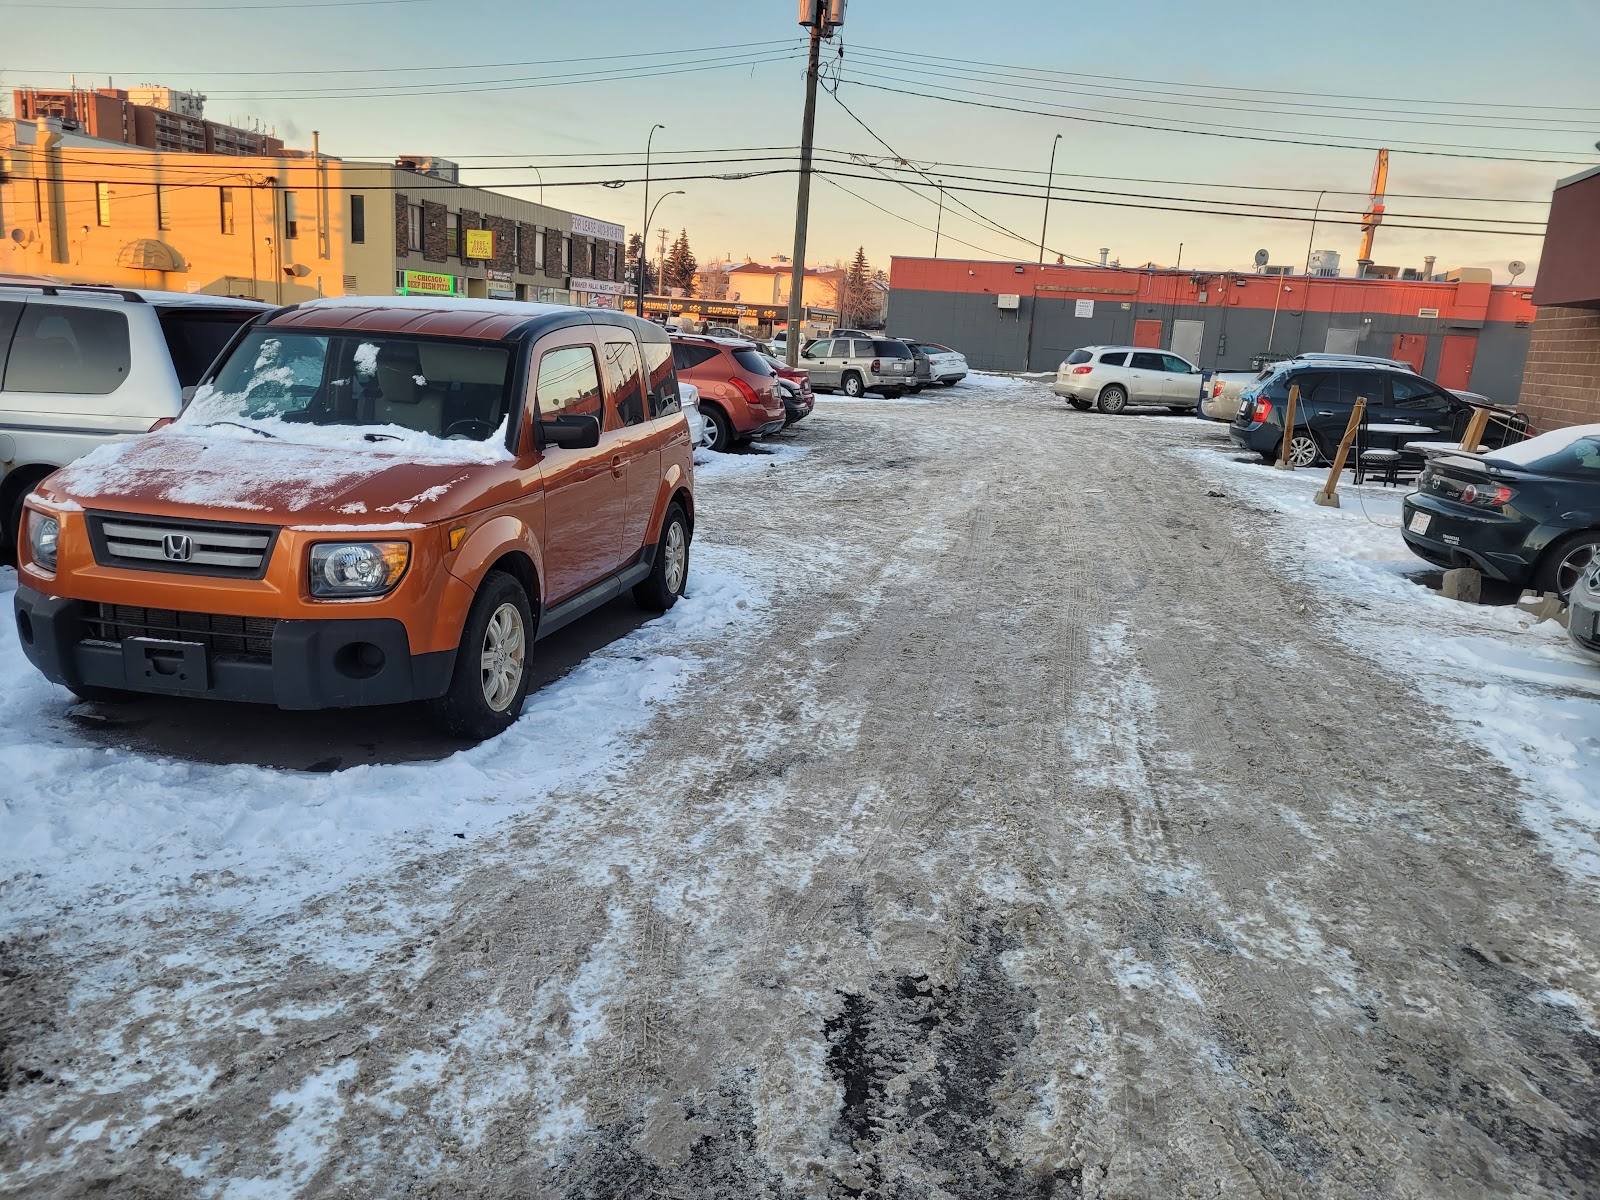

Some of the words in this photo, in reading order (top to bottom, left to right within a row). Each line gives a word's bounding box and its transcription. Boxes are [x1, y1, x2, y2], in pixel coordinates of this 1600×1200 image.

[572, 216, 582, 231] FOR
[582, 219, 596, 234] LEASE
[417, 274, 443, 283] CHICAGO
[408, 280, 421, 289] DEEP
[421, 282, 436, 291] DISH
[437, 284, 451, 292] PIZZA
[643, 301, 683, 311] PAWNSHOP
[708, 306, 758, 317] SUPERSTORE
